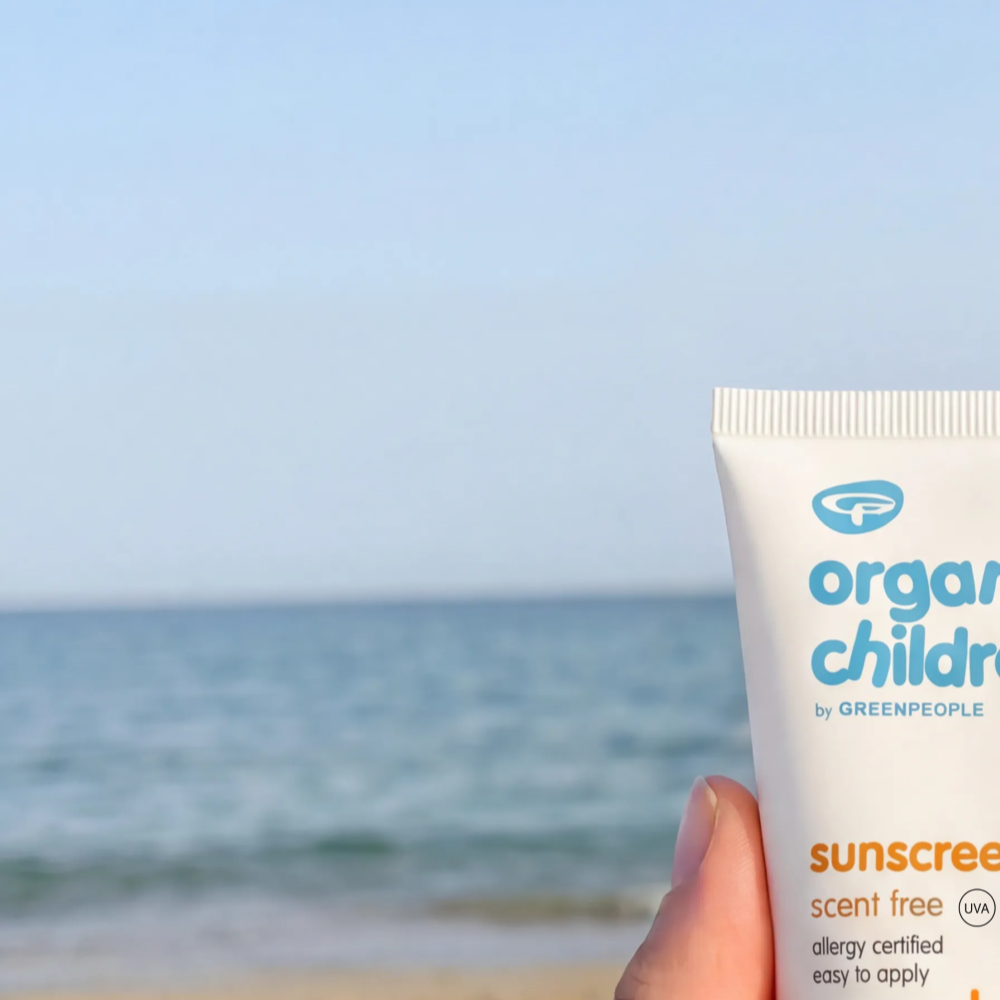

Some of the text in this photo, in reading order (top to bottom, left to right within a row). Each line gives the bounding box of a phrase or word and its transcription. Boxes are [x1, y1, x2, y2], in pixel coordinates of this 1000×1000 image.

[815, 701, 984, 721] by GREENPEOPLE
[811, 889, 943, 918] scent free
[965, 903, 989, 914] UVA
[812, 934, 943, 960] allergy certified
[813, 963, 929, 988] easy to apply
